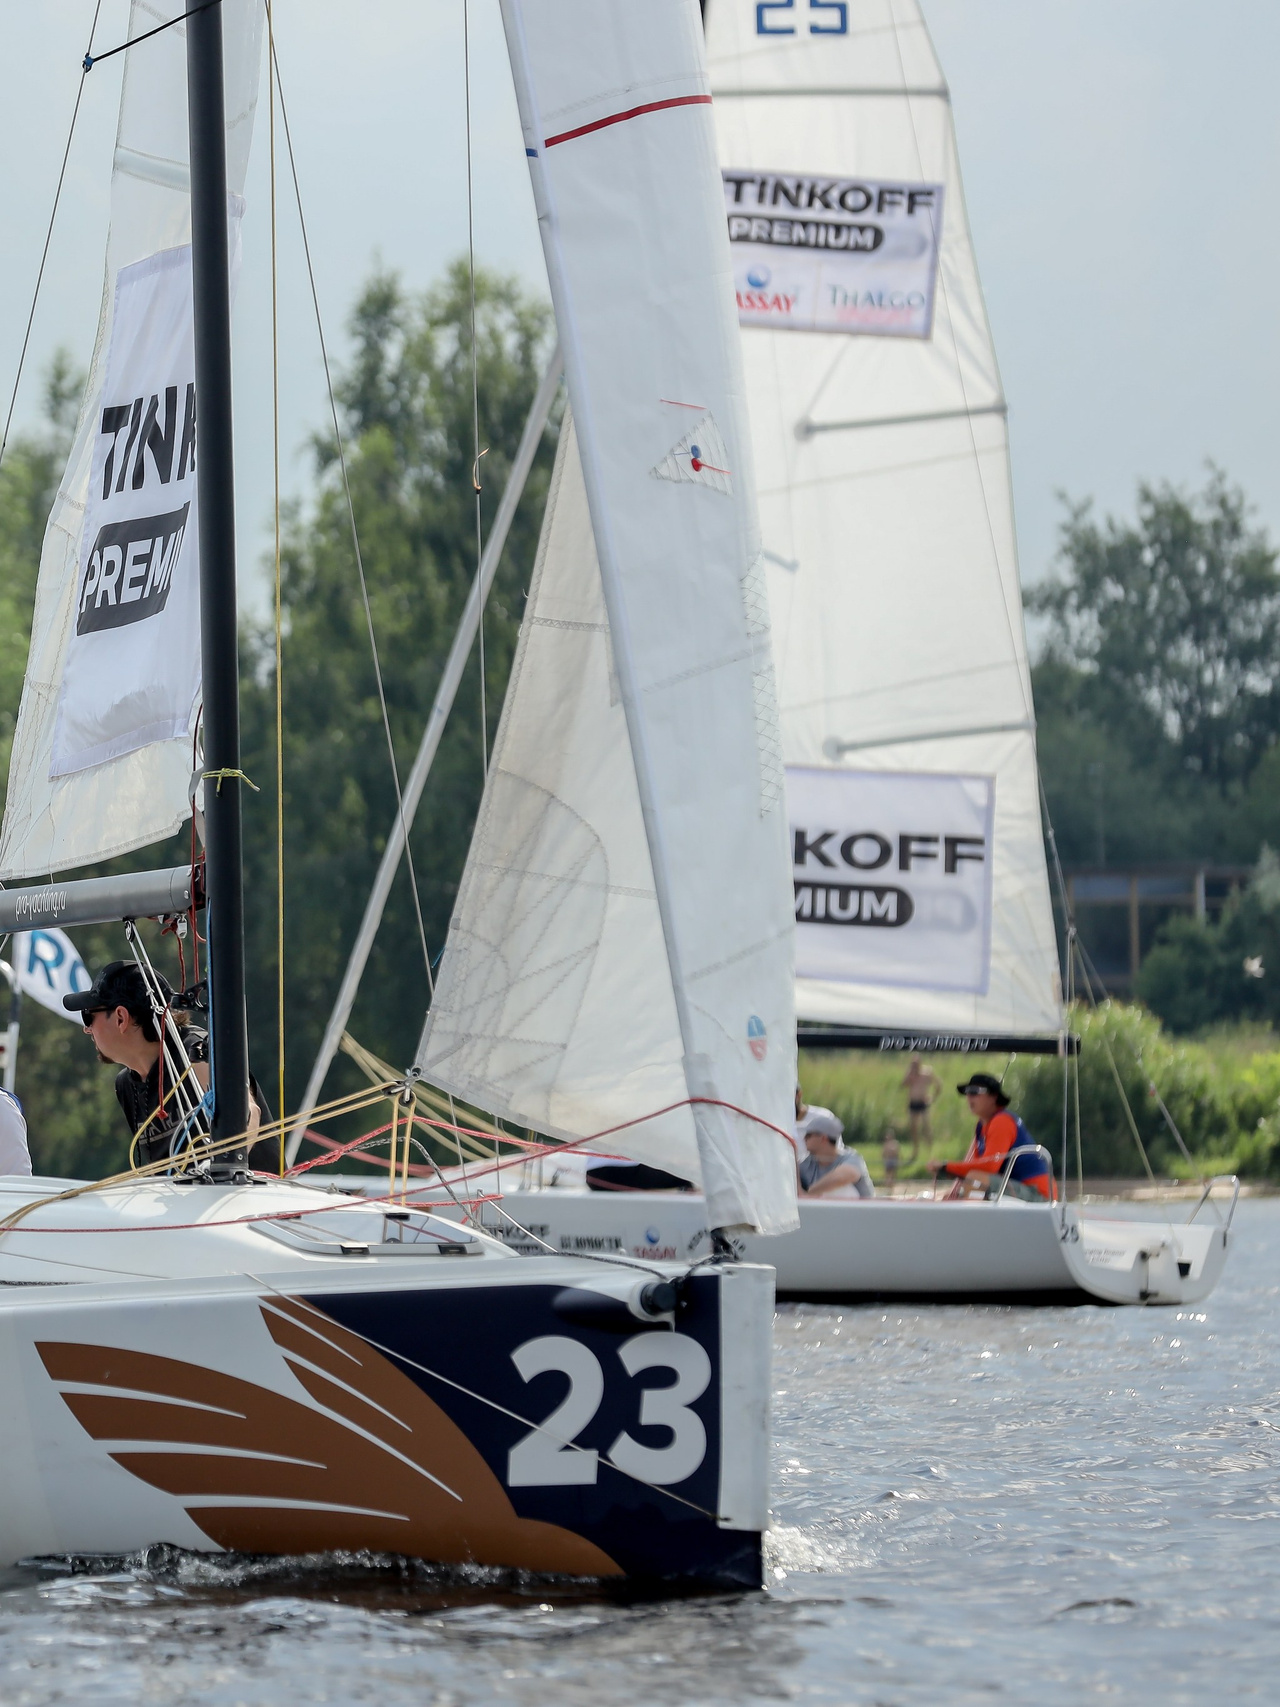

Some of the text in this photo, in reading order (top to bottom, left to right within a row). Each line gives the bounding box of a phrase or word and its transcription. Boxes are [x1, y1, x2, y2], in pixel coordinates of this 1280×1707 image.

[756, 0, 847, 34] 25
[725, 176, 934, 216] TINKOFF
[729, 217, 875, 250] PREMIUM
[736, 291, 797, 313] ASSAY
[794, 829, 985, 874] KOFF
[795, 886, 898, 922] MIUM
[507, 1330, 712, 1488] 23
